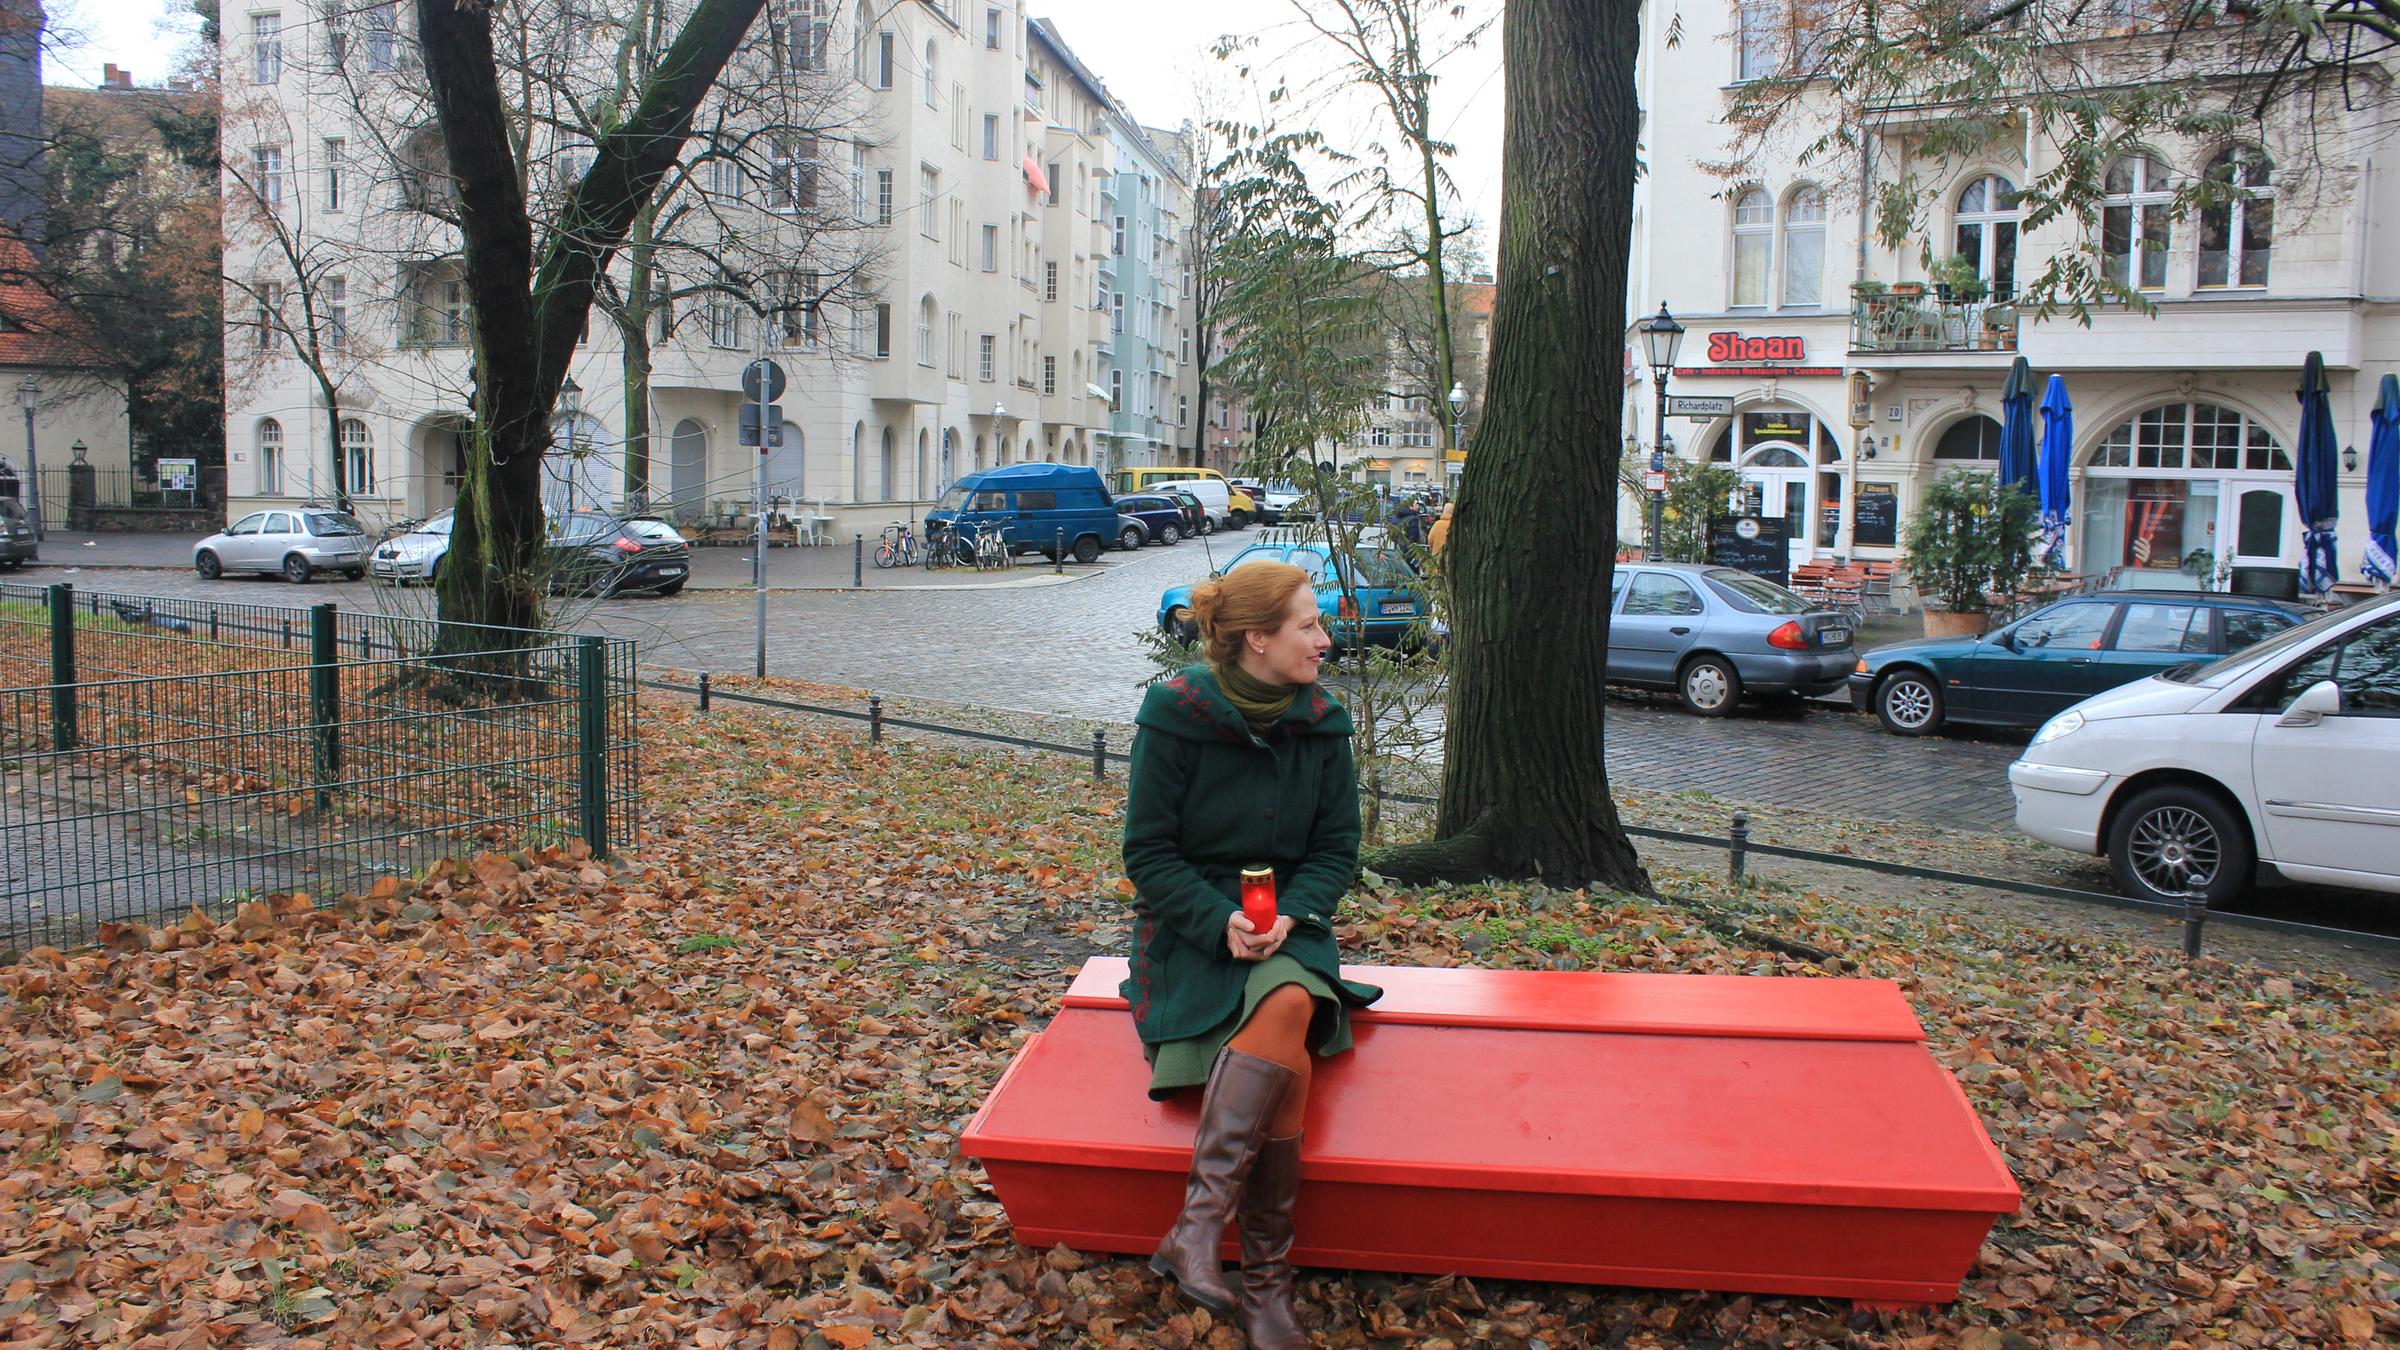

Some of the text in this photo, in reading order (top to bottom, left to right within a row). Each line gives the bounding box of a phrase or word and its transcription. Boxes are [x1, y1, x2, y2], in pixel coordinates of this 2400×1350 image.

[1708, 332, 1804, 362] Shaan
[1743, 367, 1787, 375] Restaurant
[1677, 400, 1723, 411] Richardplatz
[1888, 407, 1900, 417] 20
